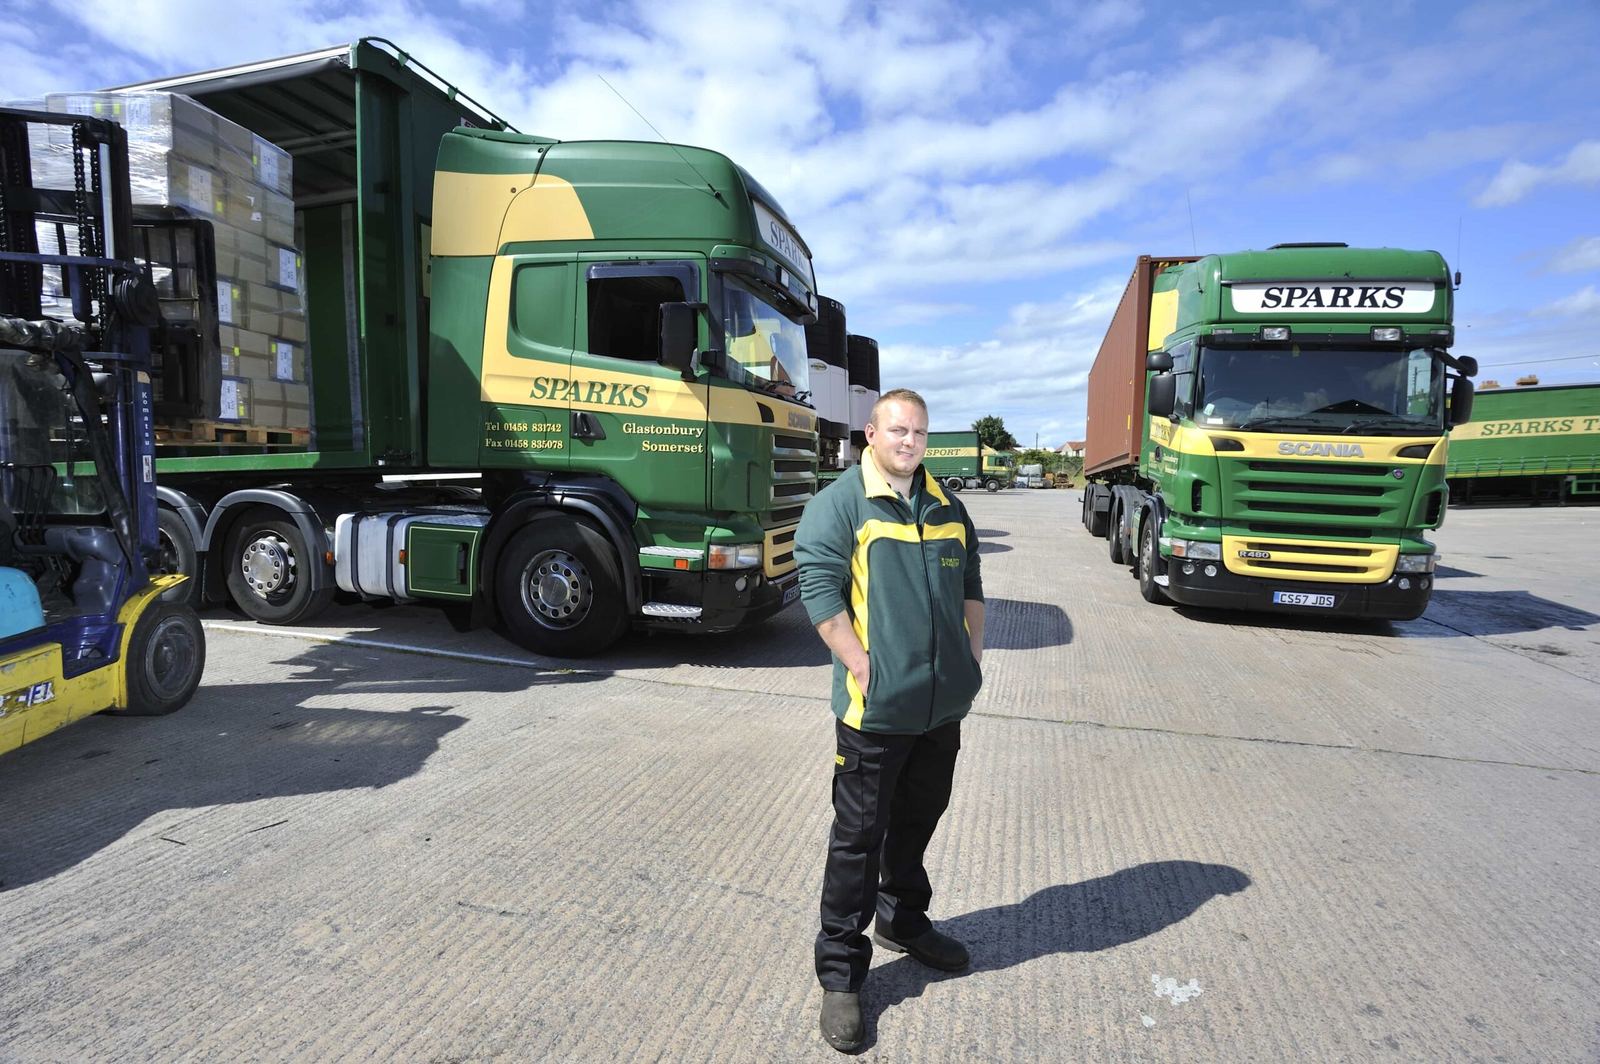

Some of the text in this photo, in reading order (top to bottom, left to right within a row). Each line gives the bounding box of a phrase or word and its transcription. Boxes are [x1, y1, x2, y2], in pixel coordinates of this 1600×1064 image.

[1261, 286, 1406, 309] SPARKS
[529, 376, 650, 408] SPARKS
[141, 391, 150, 446] Komatsu
[484, 422, 562, 432] Tel 01458 831742
[622, 422, 704, 438] Glastonbury
[1481, 418, 1600, 436] SPARKS T
[484, 438, 563, 449] Fax 01458 835078
[642, 440, 704, 453] Somerset
[1278, 441, 1364, 458] SCANIA
[926, 448, 961, 457] SPORT
[1280, 593, 1333, 606] CS57 JDS
